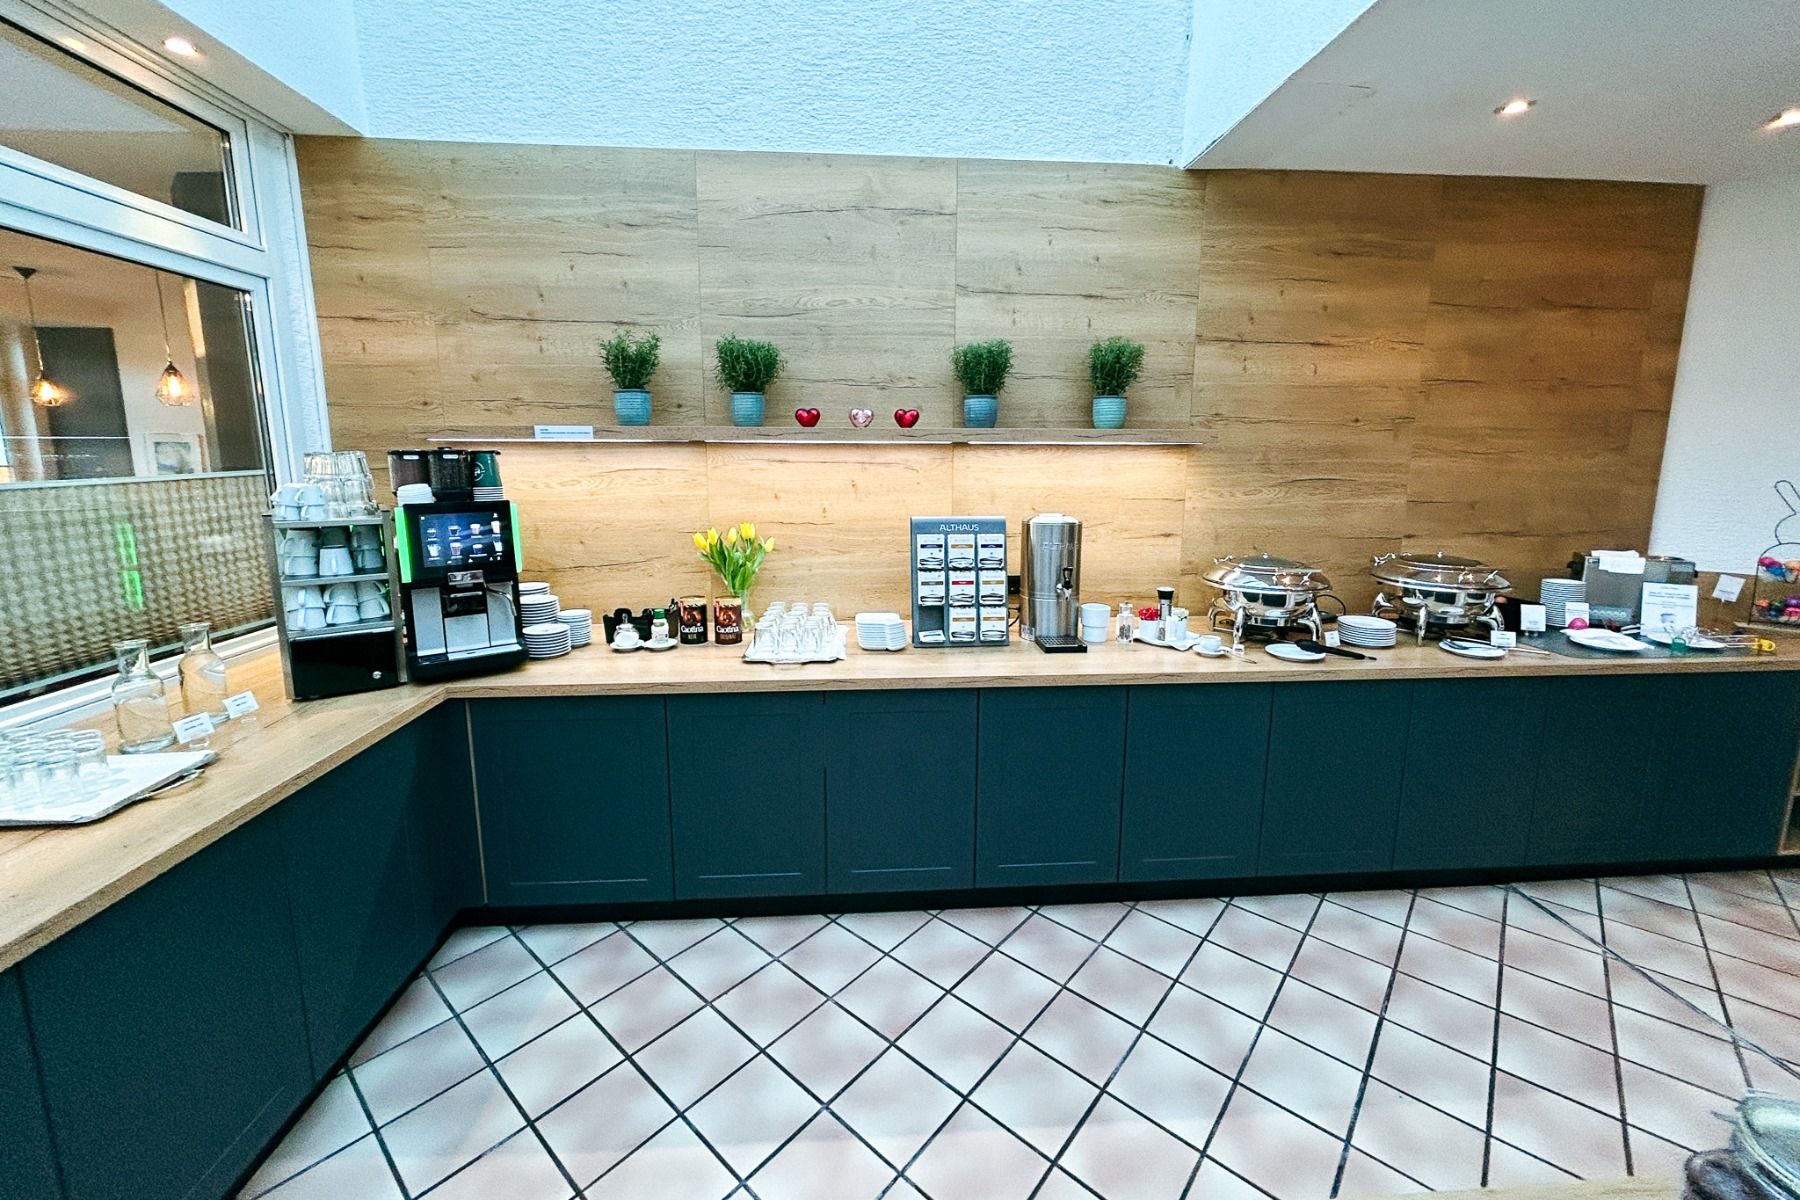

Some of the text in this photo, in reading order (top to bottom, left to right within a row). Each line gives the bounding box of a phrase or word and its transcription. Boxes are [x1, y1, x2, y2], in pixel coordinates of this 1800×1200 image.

[939, 524, 980, 532] ALTHAUS
[681, 623, 704, 633] Caotina
[716, 623, 739, 633] Caotina
